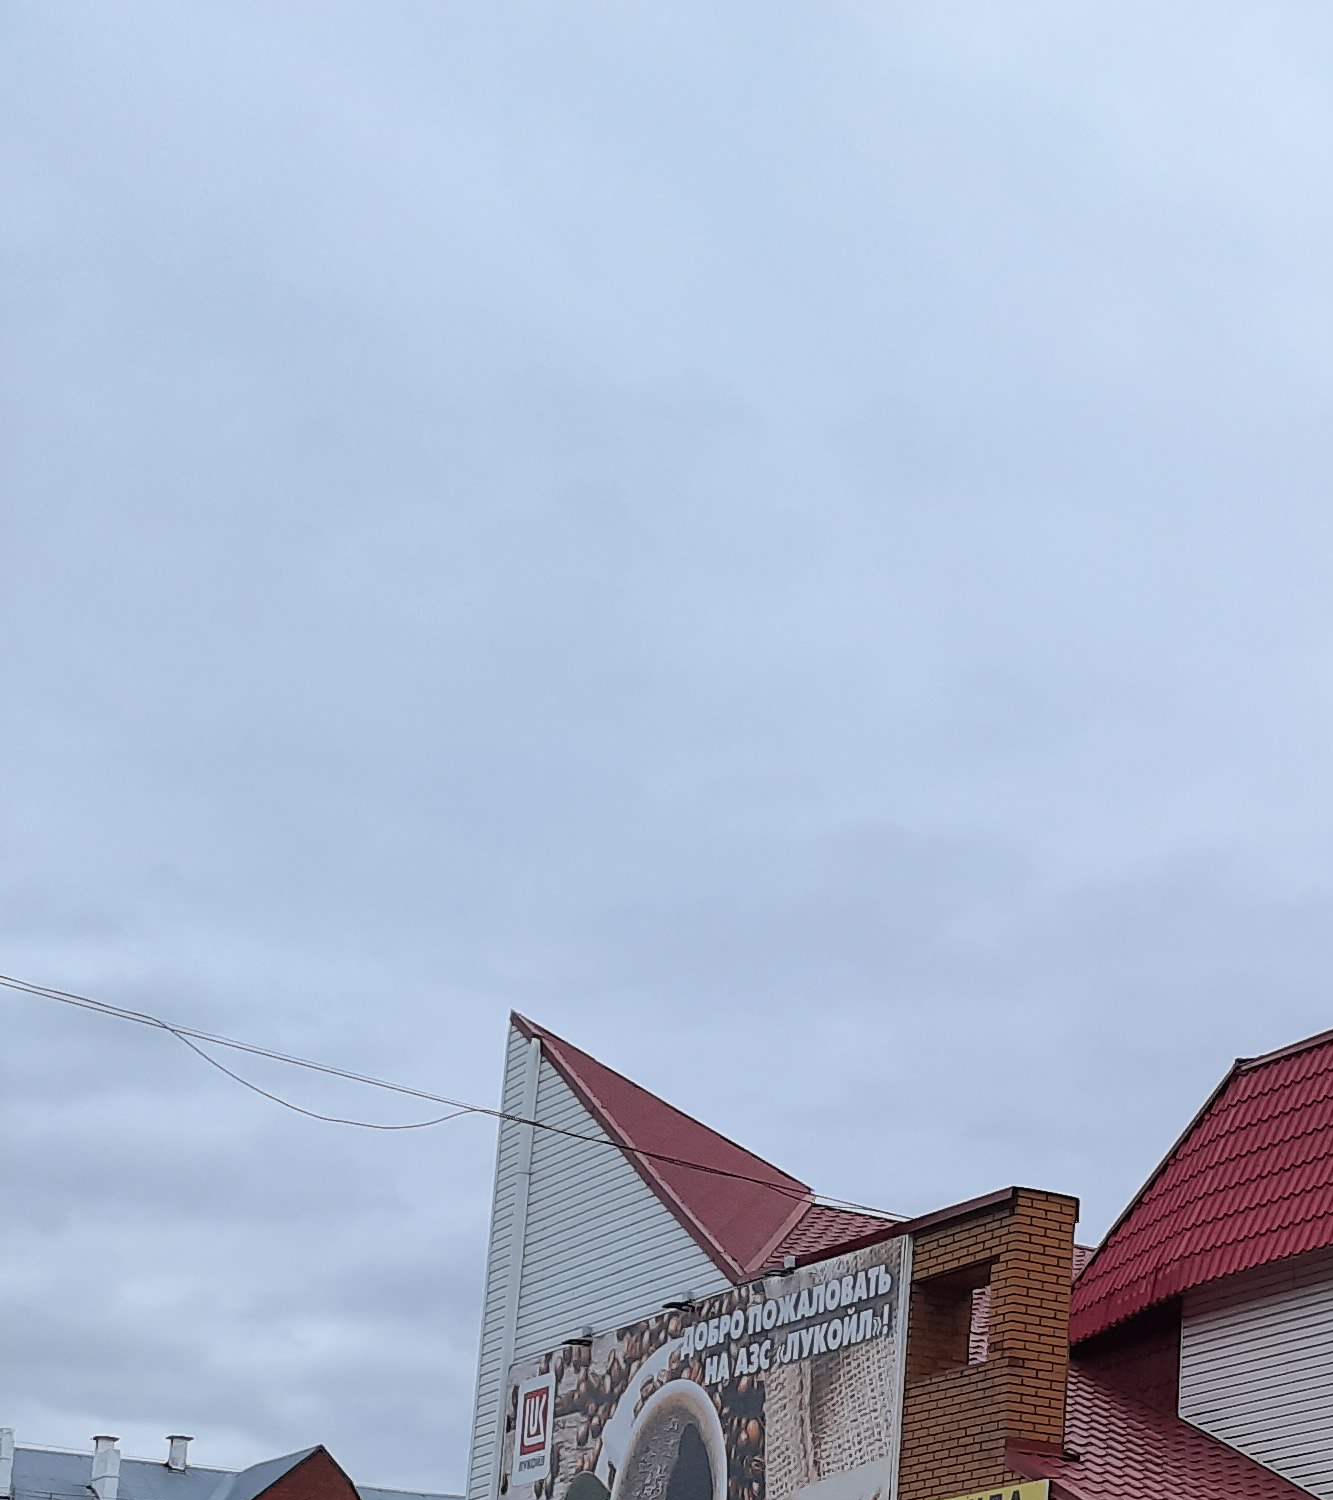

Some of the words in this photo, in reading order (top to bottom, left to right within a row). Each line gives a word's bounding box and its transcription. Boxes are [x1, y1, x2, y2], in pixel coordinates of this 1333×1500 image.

[680, 1310, 744, 1360] ДОБРО
[747, 1265, 892, 1335] ПОЖАЛОВАТЬ
[704, 1353, 730, 1387] НА
[734, 1343, 771, 1374] АЗС
[777, 1304, 890, 1364] «ЛУКОЙЛ»!
